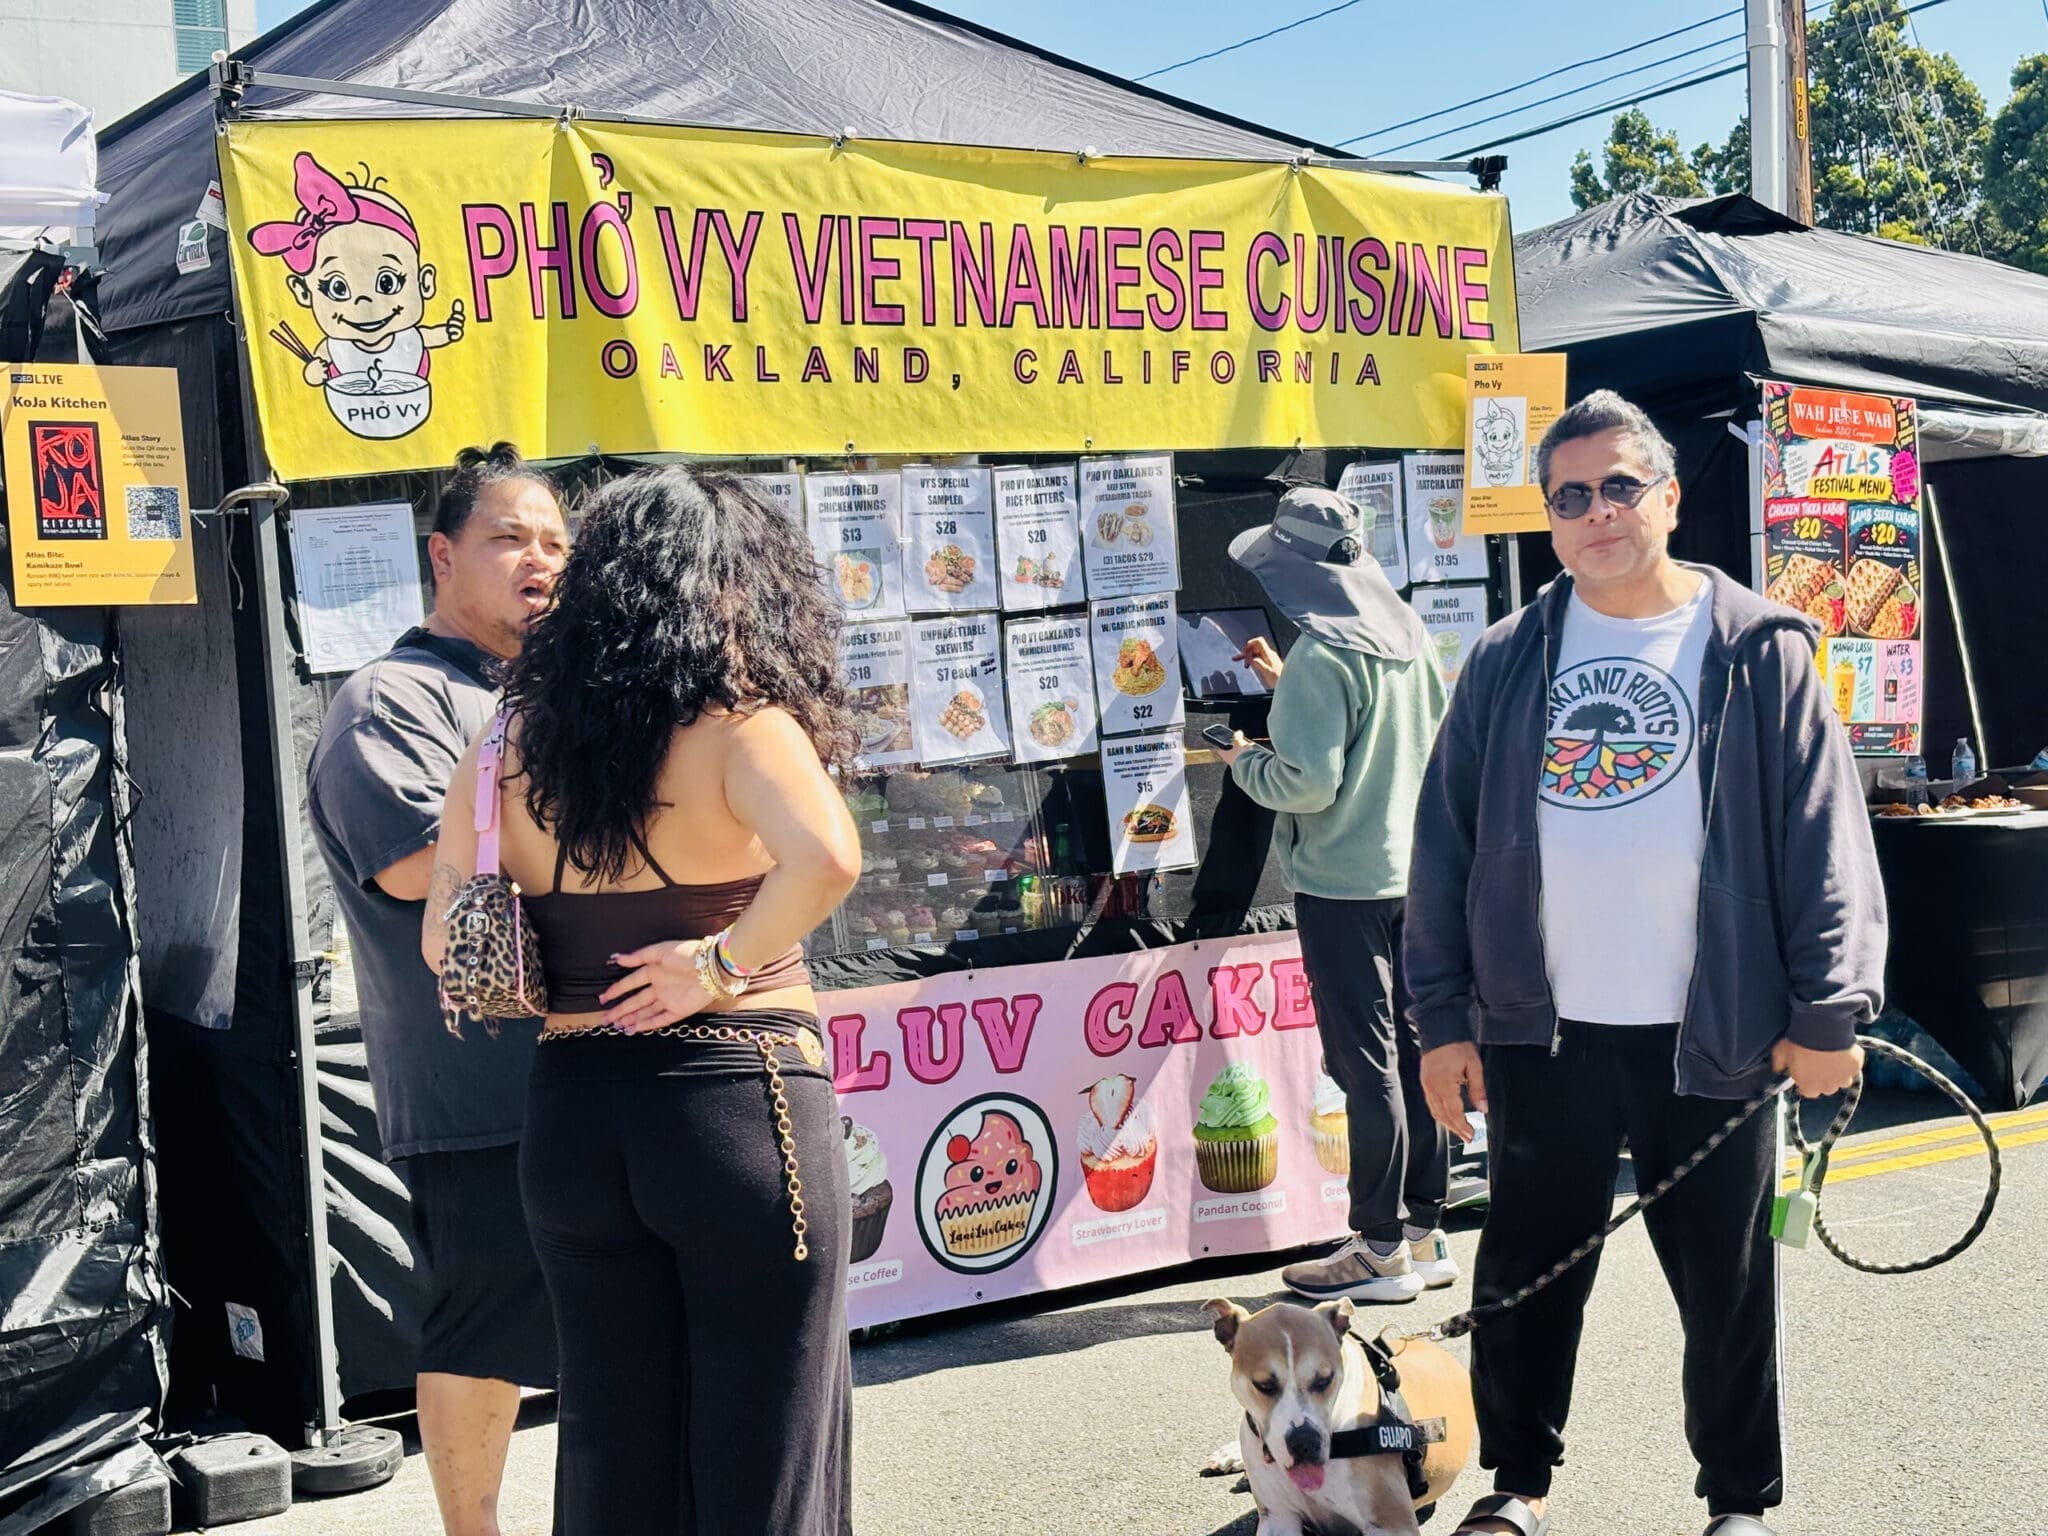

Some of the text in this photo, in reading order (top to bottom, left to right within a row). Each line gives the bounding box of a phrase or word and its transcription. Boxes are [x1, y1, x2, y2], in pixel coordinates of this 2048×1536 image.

[1797, 79, 1805, 137] 1780
[655, 206, 764, 324] VY
[782, 211, 1229, 333] VIETNAMESE
[1246, 230, 1495, 341] CUISINE
[602, 339, 1382, 390] OAKLAND, CALIFORNIA
[1488, 362, 1504, 371] LIVE
[35, 374, 64, 385] LIVE
[1474, 379, 1503, 391] Pho Vy
[13, 396, 107, 410] KoJa Kitchen
[396, 400, 423, 420] VY
[1793, 402, 1824, 421] WAH
[1863, 411, 1893, 429] WAH
[141, 434, 161, 443] Story
[1815, 423, 1876, 442] Indian BBQ Company
[1834, 441, 1856, 452] KQED
[1812, 445, 1880, 477] ATLAS
[1086, 465, 1163, 482] PHO VY OAKLAND'S
[823, 483, 879, 497] JUMBO FRIED
[920, 477, 970, 489] VY'S SPECIAL
[1000, 475, 1069, 492] PHO VY OAKLAND'S
[1119, 481, 1137, 490] STEW
[1416, 478, 1464, 490] MATCHA LATT
[1813, 477, 1886, 495] FESTIVAL MENU
[927, 495, 964, 506] SAMPLER
[1005, 491, 1066, 508] RICE PLATTERS
[1132, 490, 1152, 499] TACOS
[818, 498, 887, 514] CHICKEN WINGS
[1767, 502, 1800, 518] CHICKEN
[1801, 502, 1822, 516] TIKKA
[42, 519, 102, 529] KITCHEN
[1850, 508, 1872, 524] LAMB
[842, 527, 862, 543] $13
[935, 521, 957, 536] $28
[1027, 529, 1047, 544] $20
[1791, 517, 1822, 540] $20
[1871, 522, 1897, 545] $20
[1113, 552, 1137, 564] TACOS
[1138, 551, 1154, 562] $20
[1434, 554, 1459, 567] $7.95
[1097, 600, 1169, 618] FRIED CHICKEN WINGS
[1432, 598, 1460, 610] MANGO
[1136, 616, 1166, 629] NOODLES
[1452, 611, 1475, 623] LATTE
[869, 630, 902, 644] SALAD
[1011, 633, 1027, 645] PHO
[1038, 628, 1081, 642] OAKLAND'S
[935, 640, 975, 656] SKEWERS
[1018, 642, 1075, 657] VERMICELLI BOWLS
[1831, 641, 1873, 656] MANGO LASSI
[1886, 644, 1911, 656] WATER
[850, 665, 871, 682] $18
[936, 668, 949, 682] $7
[951, 664, 977, 680] each
[1857, 656, 1873, 675] $7
[1900, 659, 1913, 675] $3
[1039, 675, 1059, 690] $20
[1548, 667, 1679, 737] AKLAND ROOTS
[1133, 704, 1153, 719] $22
[1125, 744, 1134, 755] MI
[1134, 740, 1177, 753] SANDWICHES
[1137, 780, 1153, 794] $15
[828, 957, 1316, 1094] LUV CAKE
[1198, 1198, 1283, 1217] Pandan Coconut
[1075, 1215, 1162, 1241] Strawberry Lover
[863, 1266, 898, 1282] Coffee
[1379, 1425, 1412, 1449] GUAPO
